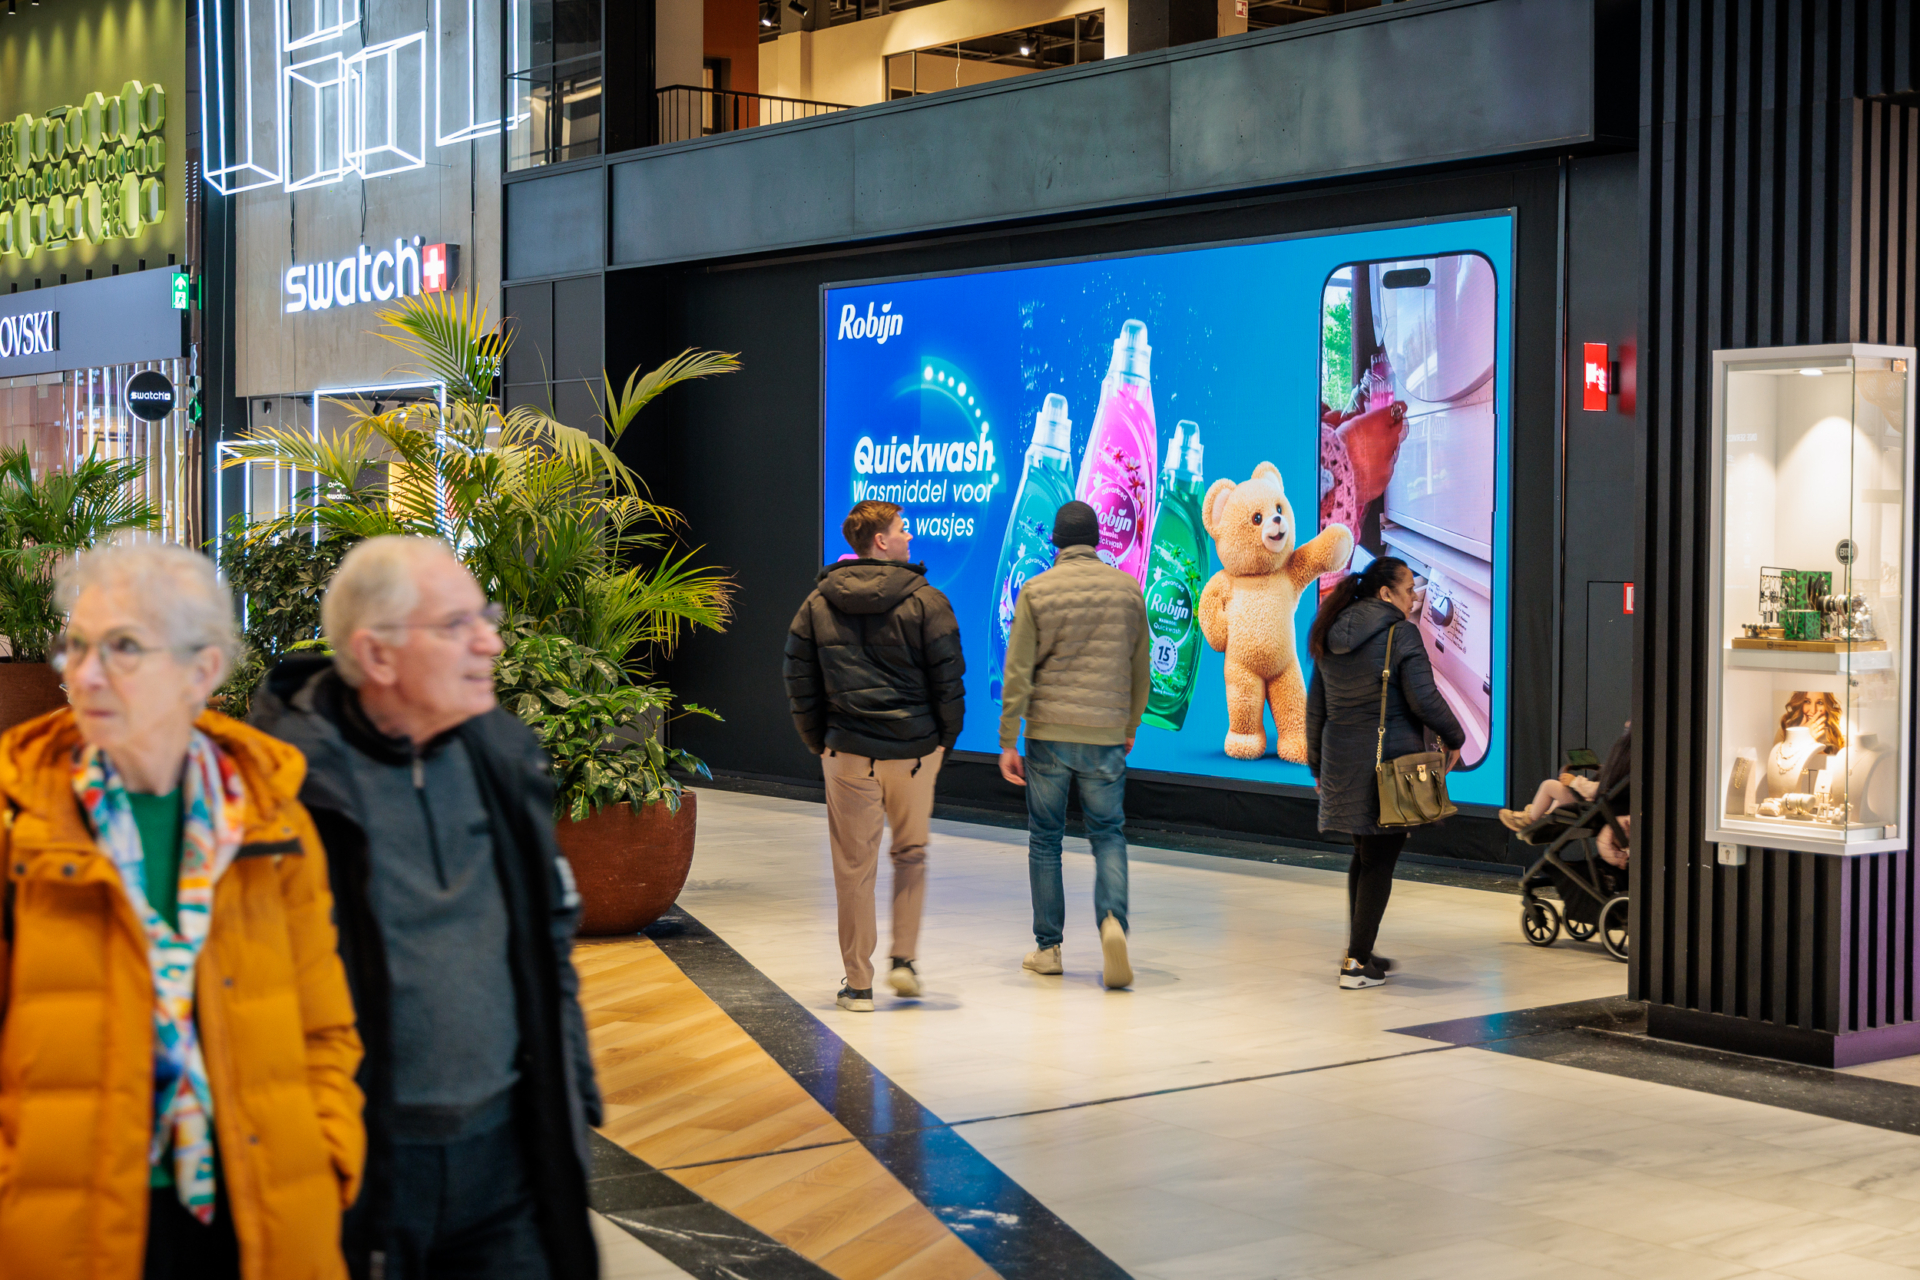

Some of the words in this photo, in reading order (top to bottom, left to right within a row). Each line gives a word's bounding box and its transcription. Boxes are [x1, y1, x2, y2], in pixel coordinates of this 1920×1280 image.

[286, 238, 420, 313] swatch
[838, 301, 903, 345] Robijn
[130, 391, 164, 400] swatch
[854, 433, 994, 474] Quickwash
[853, 479, 947, 502] Wasmiddel
[953, 483, 993, 502] voor
[916, 512, 974, 542] wasjes
[1150, 593, 1189, 621] Robijn
[1158, 645, 1171, 662] 15
